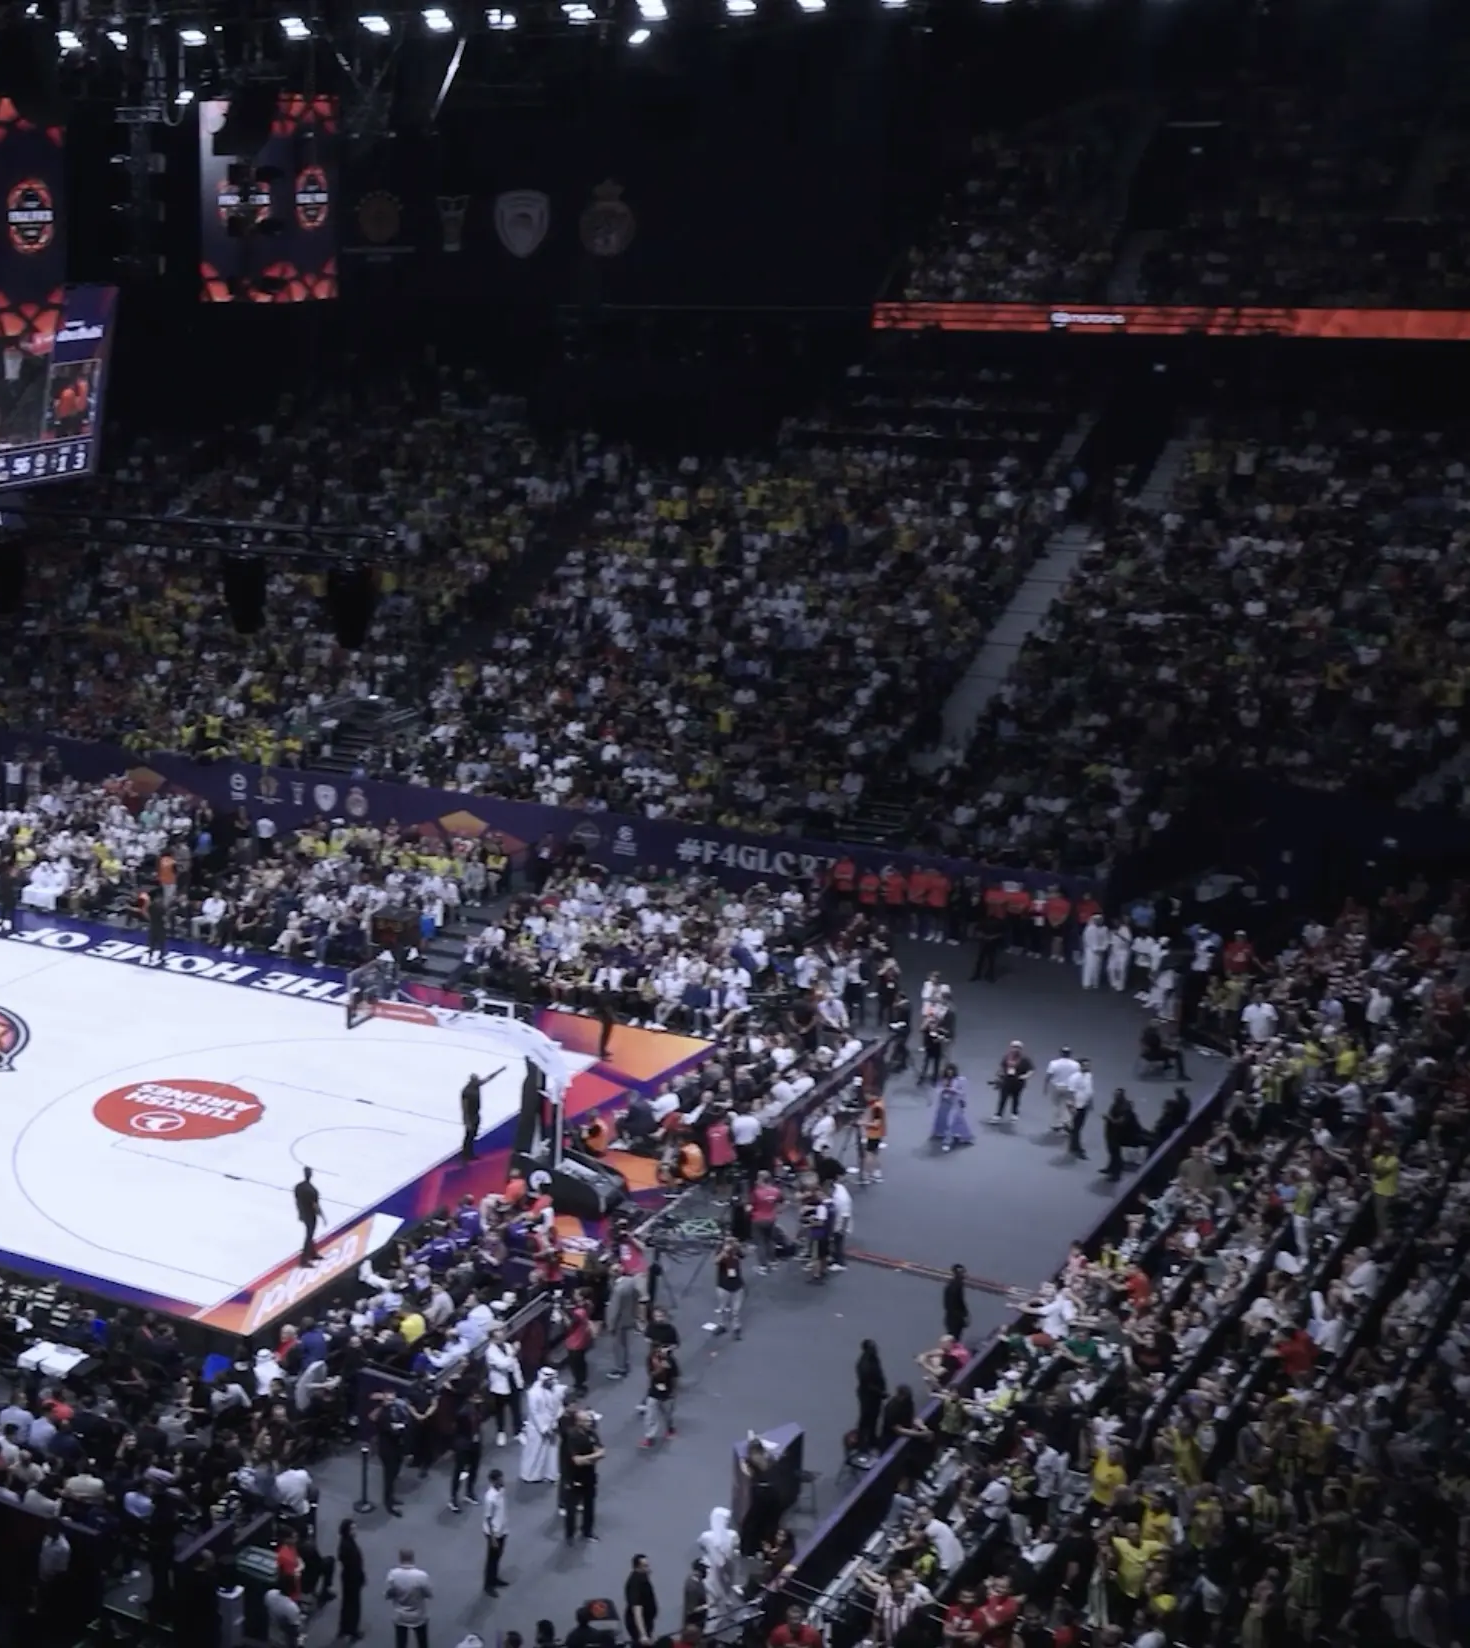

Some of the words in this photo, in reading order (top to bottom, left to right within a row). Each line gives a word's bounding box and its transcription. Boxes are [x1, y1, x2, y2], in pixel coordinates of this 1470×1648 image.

[72, 452, 86, 469] 3
[677, 837, 837, 880] #F4GLOR
[8, 928, 91, 949] OF
[84, 940, 260, 982] HOME
[250, 971, 353, 1004] THE
[124, 1090, 237, 1121] TURKISH
[136, 1083, 260, 1112] AIRLINES
